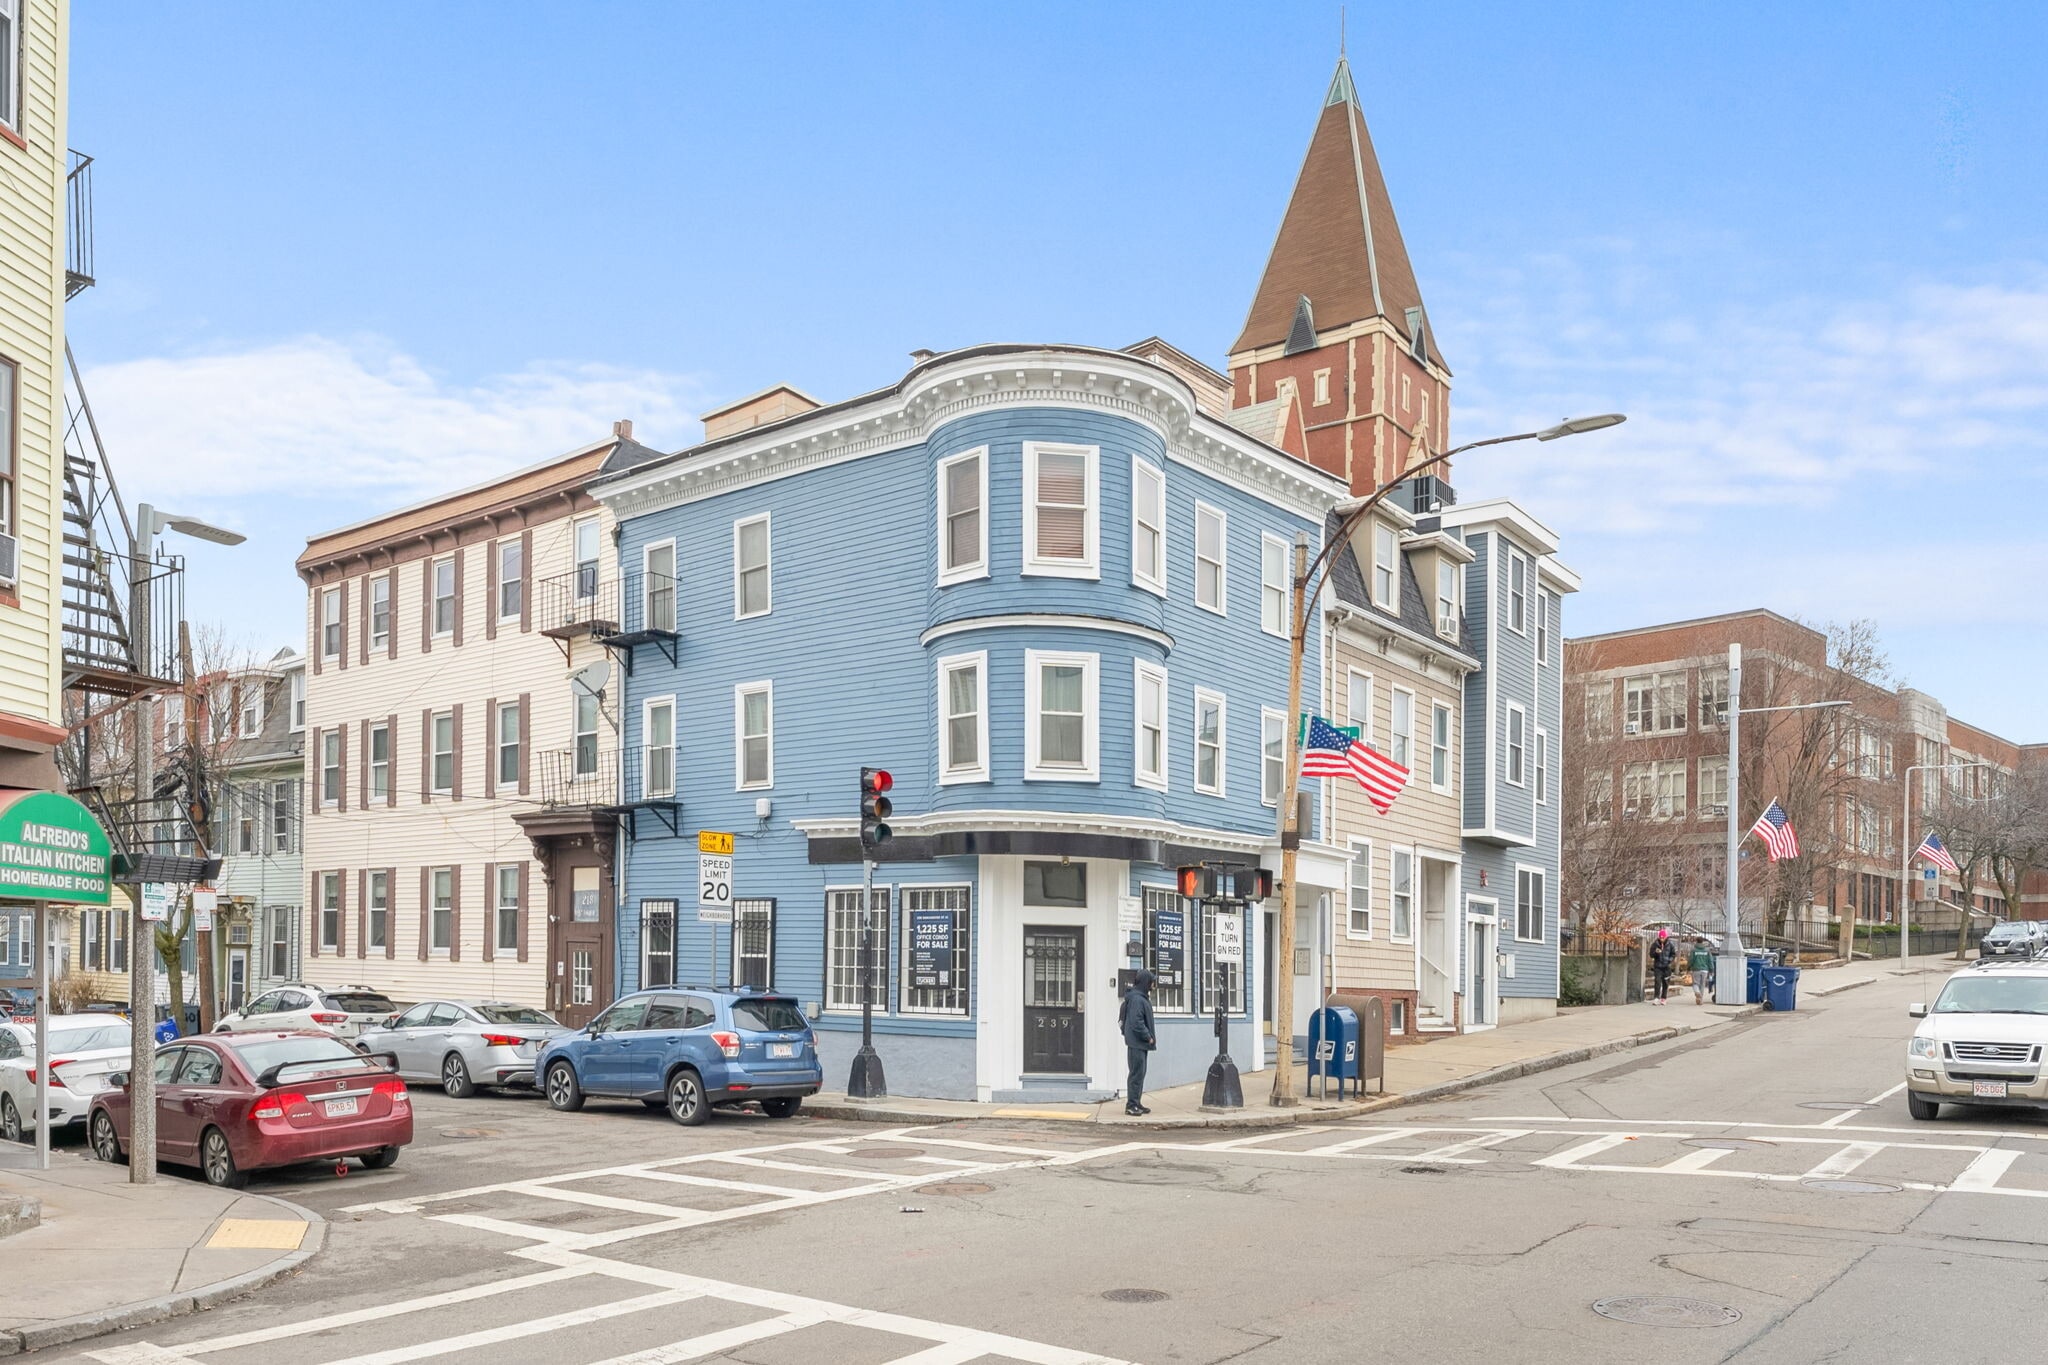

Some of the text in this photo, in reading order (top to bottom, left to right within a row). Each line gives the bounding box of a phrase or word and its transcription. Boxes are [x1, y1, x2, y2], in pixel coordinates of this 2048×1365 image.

[23, 823, 89, 851] ALFREDO'S
[2, 843, 105, 874] ITALIAN KITCHEN
[702, 859, 730, 869] SPEED
[704, 870, 727, 879] LIMIT
[1, 869, 105, 892] HOMEMADE FOOD
[702, 881, 729, 901] 20
[916, 924, 949, 934] 1,225 SF
[1174, 925, 1182, 935] SF
[1224, 921, 1235, 931] NO
[1221, 933, 1238, 943] TURN
[916, 940, 949, 949] FOR SALE
[1159, 940, 1182, 950] FOR SALE
[1228, 946, 1241, 956] RED
[13, 1016, 36, 1024] PUSH
[1038, 1018, 1069, 1028] 239
[1975, 1085, 1988, 1093] 925
